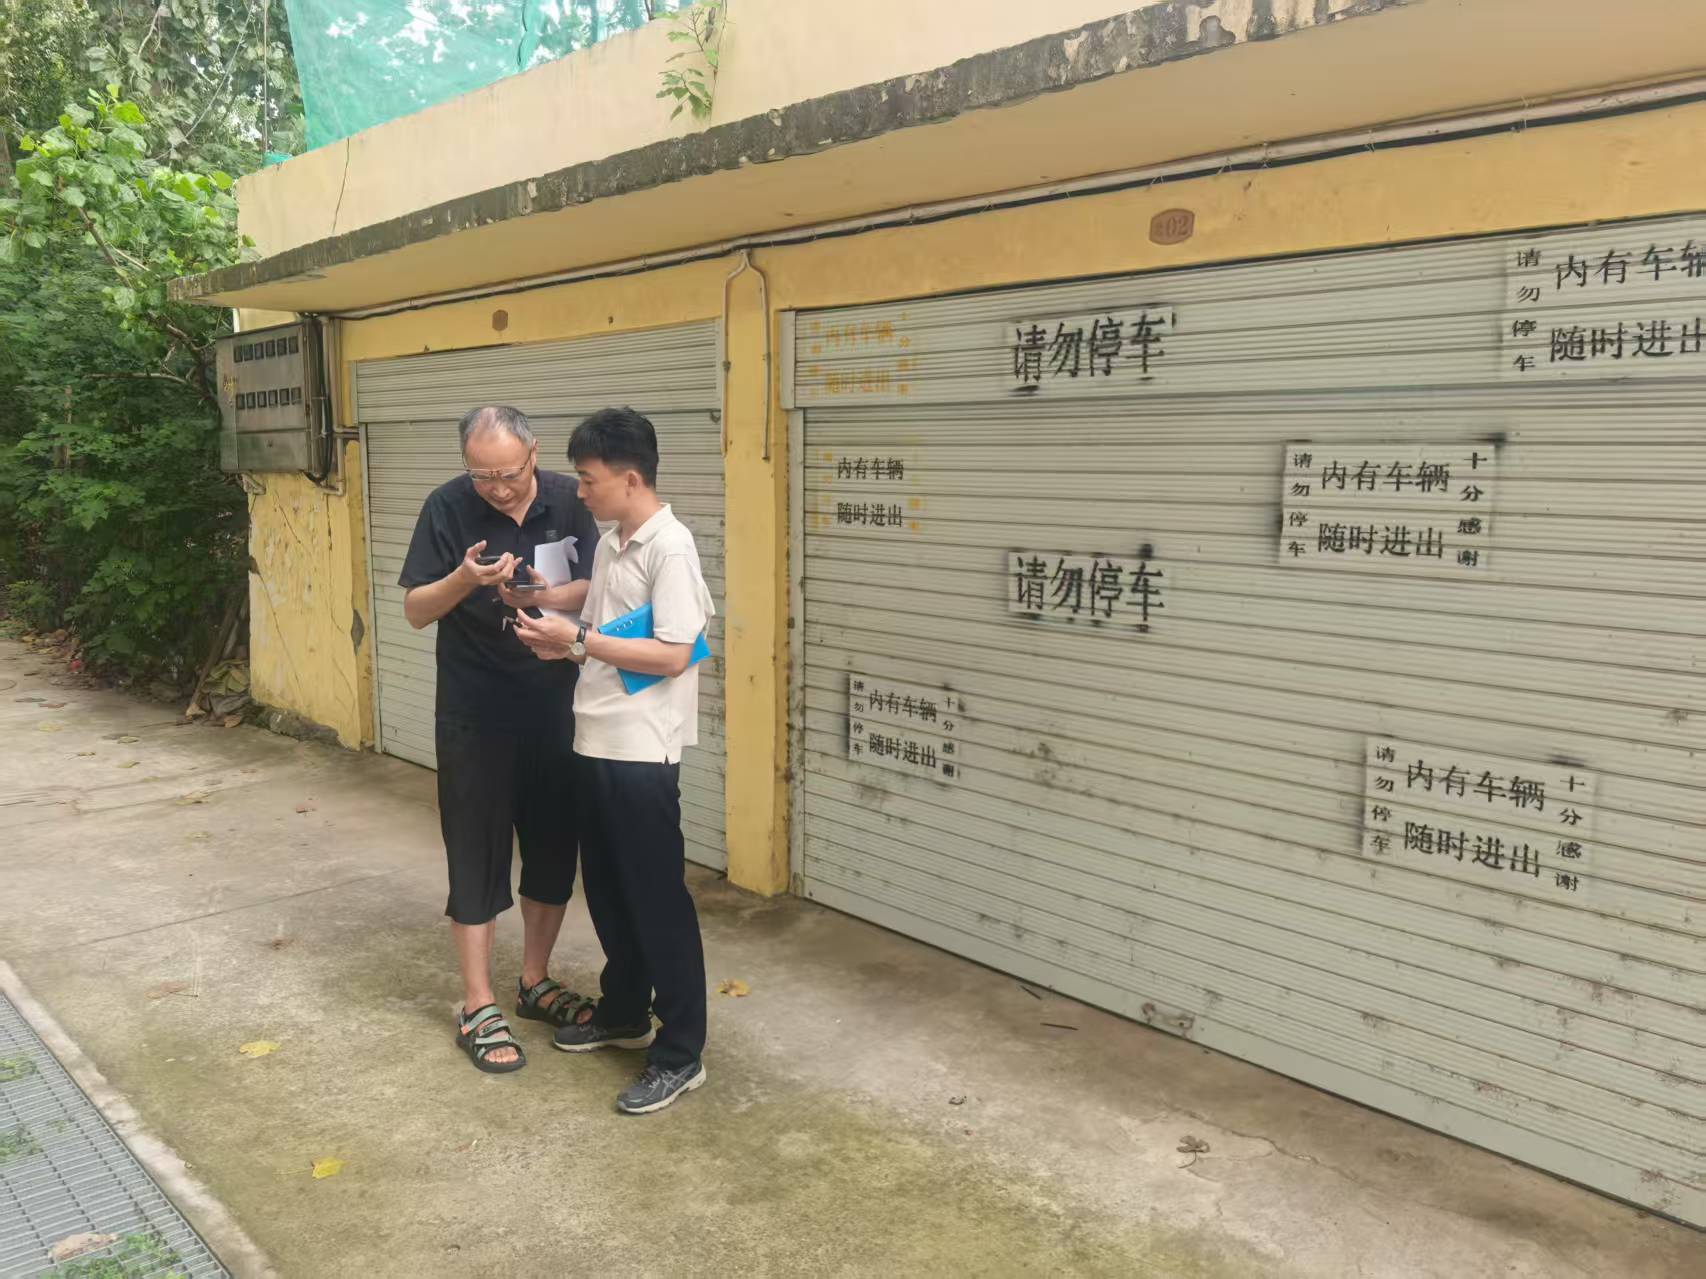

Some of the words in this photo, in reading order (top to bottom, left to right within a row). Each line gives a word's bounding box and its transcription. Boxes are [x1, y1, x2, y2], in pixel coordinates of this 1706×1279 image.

[1511, 247, 1542, 371] 请勿停车
[1012, 311, 1164, 383] 请勿停车
[837, 456, 904, 481] 内有车辆
[1321, 460, 1450, 493] 内有车辆
[837, 501, 903, 528] 随时进出
[1287, 452, 1312, 557] 请勿停车
[1457, 452, 1487, 567] 十分感谢
[1317, 522, 1444, 559] 随时进出
[1015, 555, 1164, 621] 请勿停车
[853, 680, 864, 755] 请勿停车
[869, 689, 937, 723] 内有车辆
[869, 733, 937, 768] 随时进出
[1371, 745, 1396, 855] 请勿停车
[1406, 759, 1546, 812] 内有车辆
[1404, 822, 1541, 878] 随时进出
[1555, 774, 1586, 892] 十分感谢
